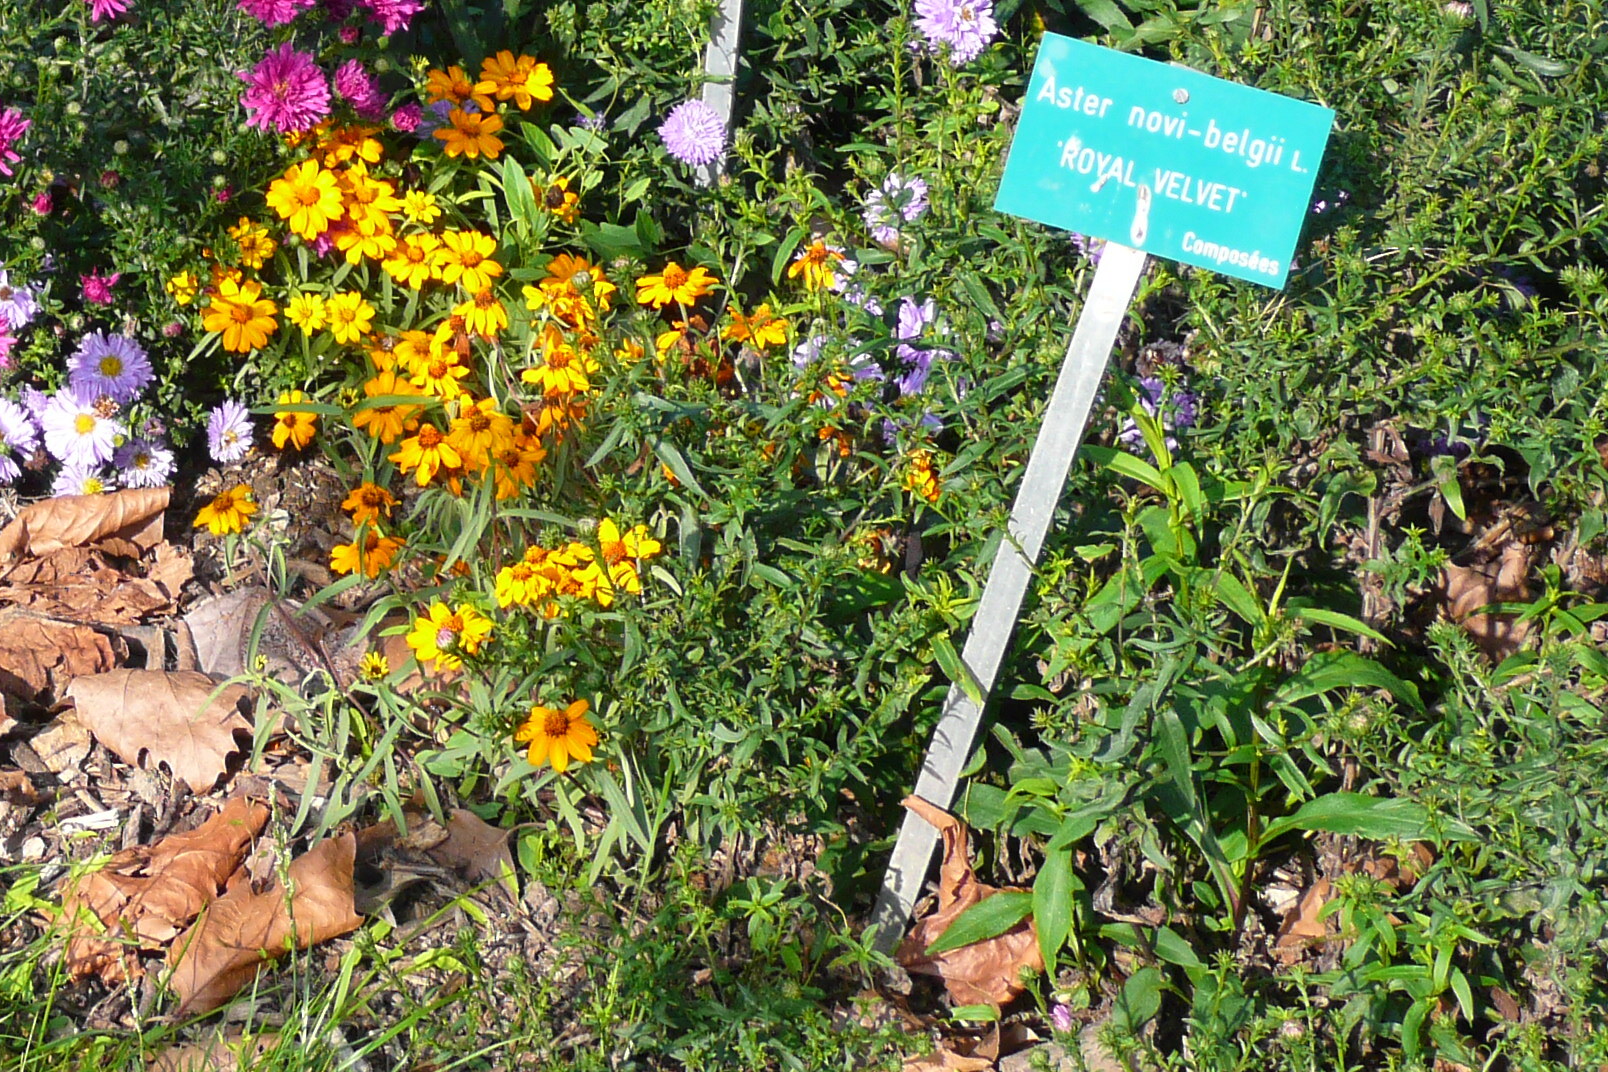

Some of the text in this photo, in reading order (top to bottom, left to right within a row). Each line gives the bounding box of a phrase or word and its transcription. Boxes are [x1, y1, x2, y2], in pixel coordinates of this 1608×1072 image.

[1037, 76, 1113, 118] Aster
[1128, 105, 1285, 168] novi-belgii
[1182, 231, 1279, 276] Composées
